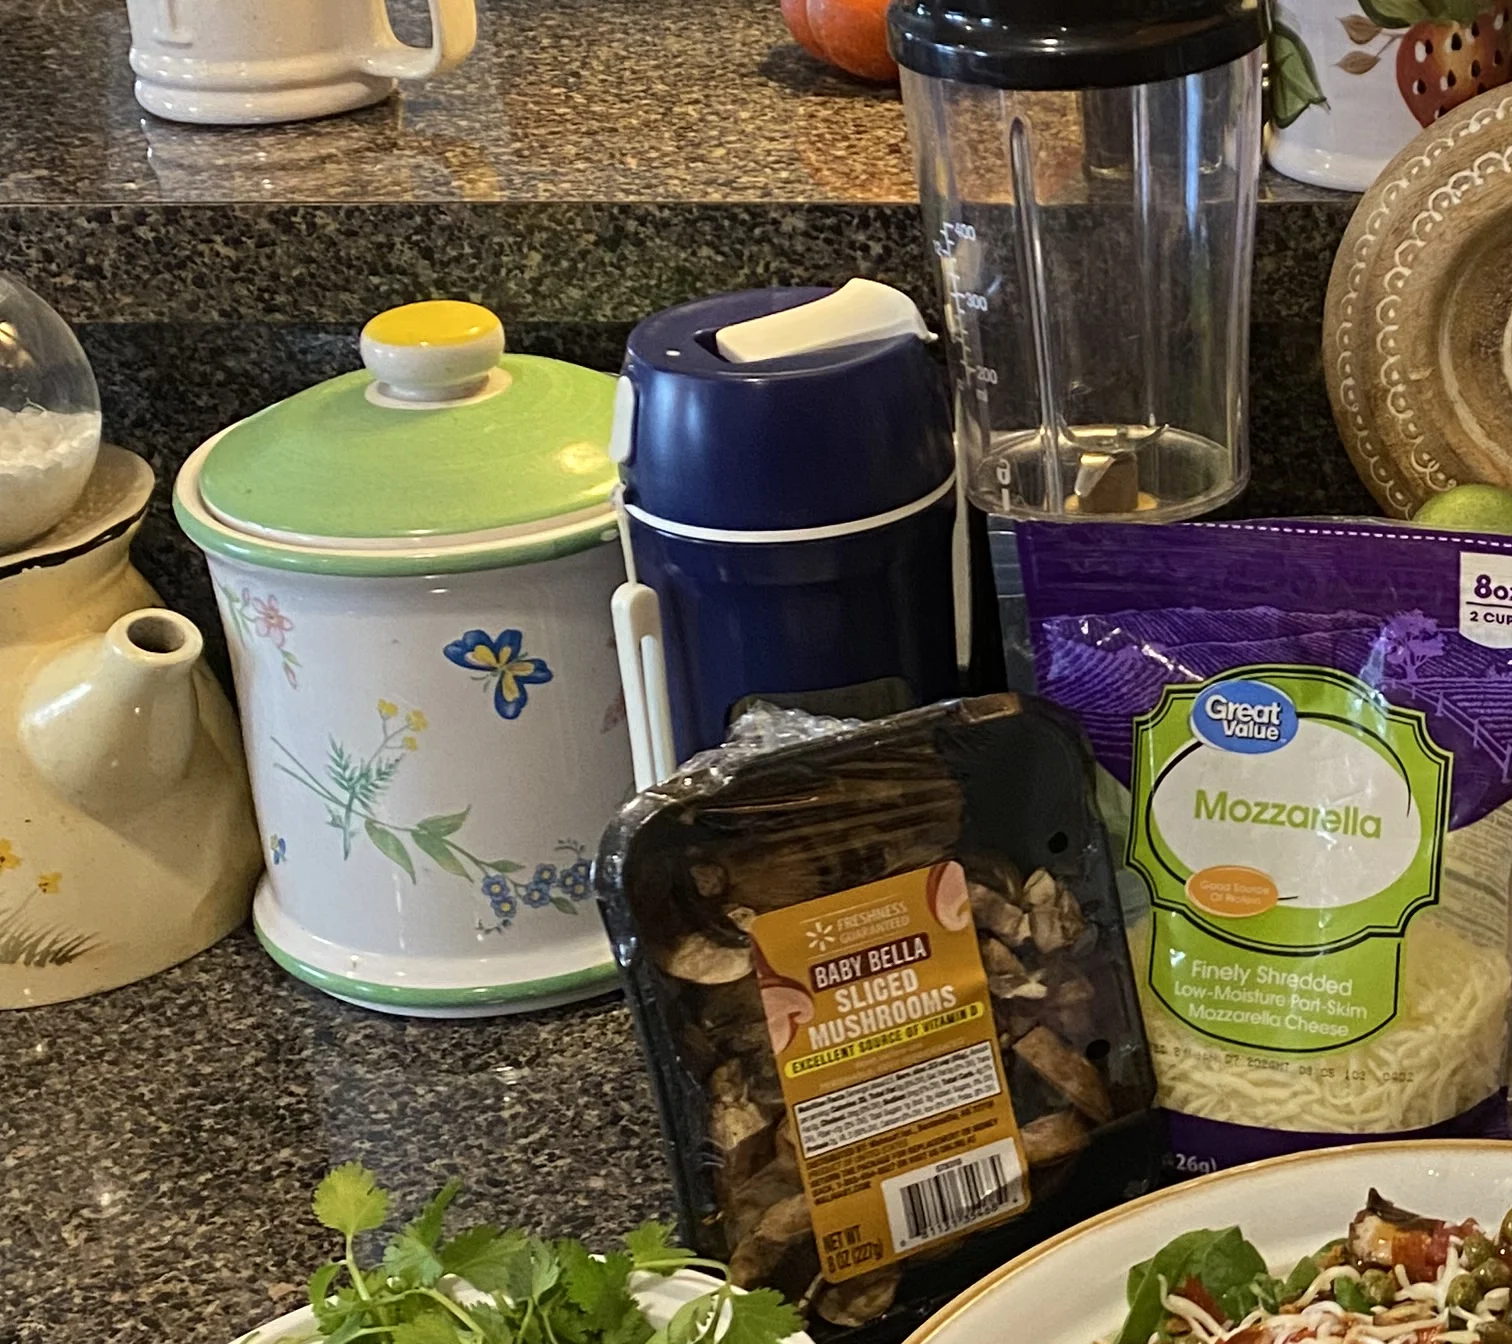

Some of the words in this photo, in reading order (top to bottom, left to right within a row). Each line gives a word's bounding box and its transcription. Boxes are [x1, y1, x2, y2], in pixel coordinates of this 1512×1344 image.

[965, 292, 988, 311] 300
[976, 365, 998, 384] 200
[1469, 611, 1479, 622] 2
[1204, 694, 1283, 726] Great
[1193, 789, 1382, 839] Mozzarella
[837, 901, 908, 931] FRESHNESS
[839, 916, 910, 944] GUARANTEED
[815, 955, 862, 989] BABY
[868, 937, 928, 972] BELLA
[1191, 960, 1252, 986] Finely
[1256, 965, 1353, 997] Shredded
[834, 968, 919, 1013] SLICED
[1174, 981, 1285, 1007] Low-Moisture
[1290, 994, 1368, 1020] Part-Skim
[808, 985, 957, 1051] MUSHROOMS
[1188, 1004, 1280, 1028] Mozzarella
[1285, 1016, 1350, 1037] Cheese
[792, 1045, 854, 1074] EXCELLENT
[860, 1032, 901, 1053] SOURCE
[905, 1025, 920, 1037] OF
[923, 1009, 967, 1033] VITAMIN
